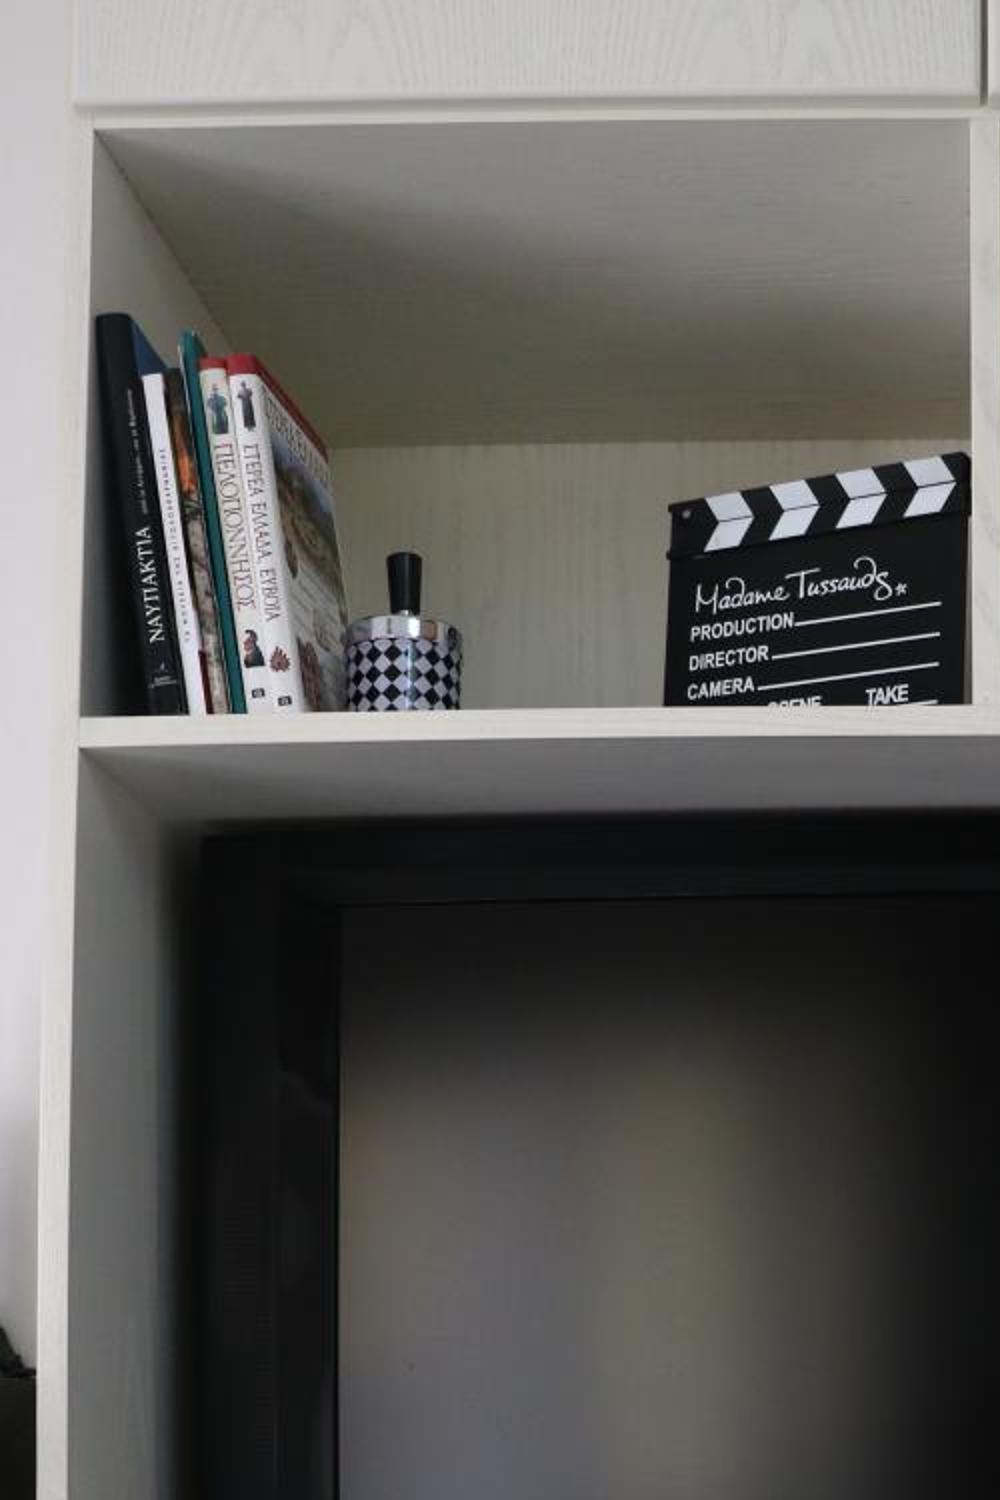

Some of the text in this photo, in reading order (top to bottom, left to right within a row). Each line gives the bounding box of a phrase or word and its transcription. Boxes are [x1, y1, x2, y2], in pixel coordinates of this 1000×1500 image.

[214, 442, 257, 613] ΠΕΛΟΠΟΝΝΗΣΟΣ
[135, 525, 165, 644] ΝΑΥΠΑΚΤΙΑ
[694, 556, 893, 615] Madame Tussauds
[690, 612, 795, 642] PRODUCTION
[688, 645, 769, 671] DIRECTOR
[687, 676, 755, 700] CAMERA
[865, 684, 909, 706] TAKE
